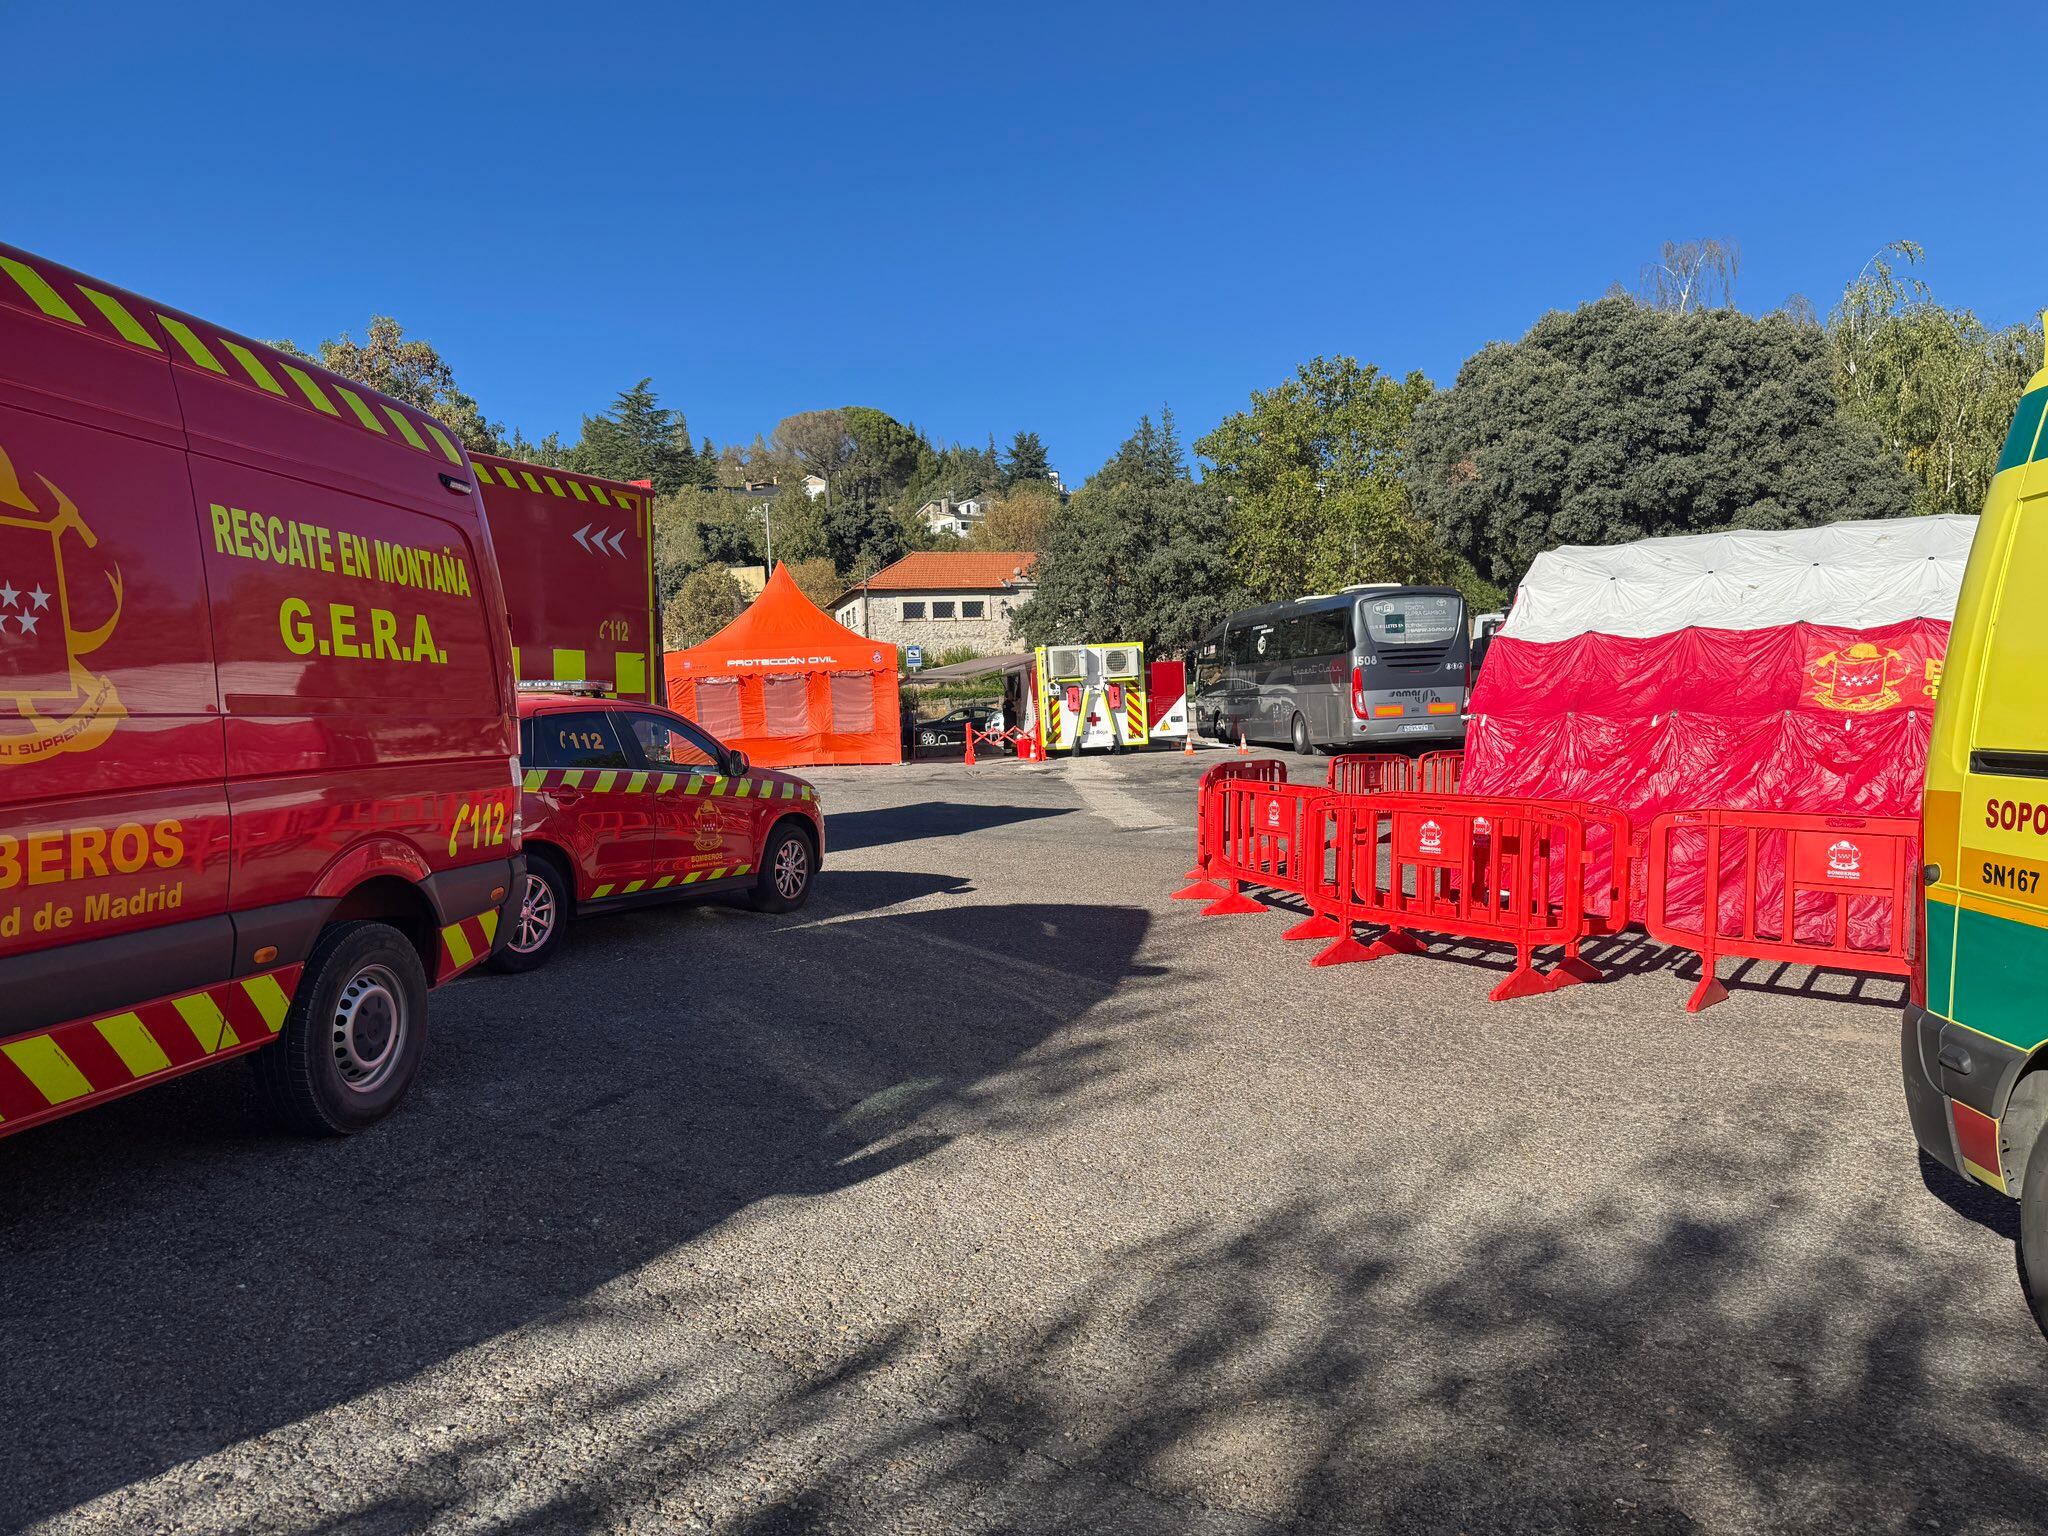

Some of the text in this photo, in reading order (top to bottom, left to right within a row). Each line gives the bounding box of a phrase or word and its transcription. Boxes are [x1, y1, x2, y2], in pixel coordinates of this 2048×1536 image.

[210, 503, 472, 598] RESCATE EN MONTAÑA
[279, 597, 448, 664] G.E.R.A.
[609, 620, 629, 642] 112
[727, 656, 837, 667] PROTECCIÓN CIVIL
[1354, 655, 1378, 666] 1508
[569, 732, 604, 750] 112
[471, 802, 504, 849] 112
[1985, 798, 2048, 836] SOPO
[1982, 862, 2040, 894] SN167
[33, 902, 73, 932] de
[84, 882, 183, 924] Madrid
